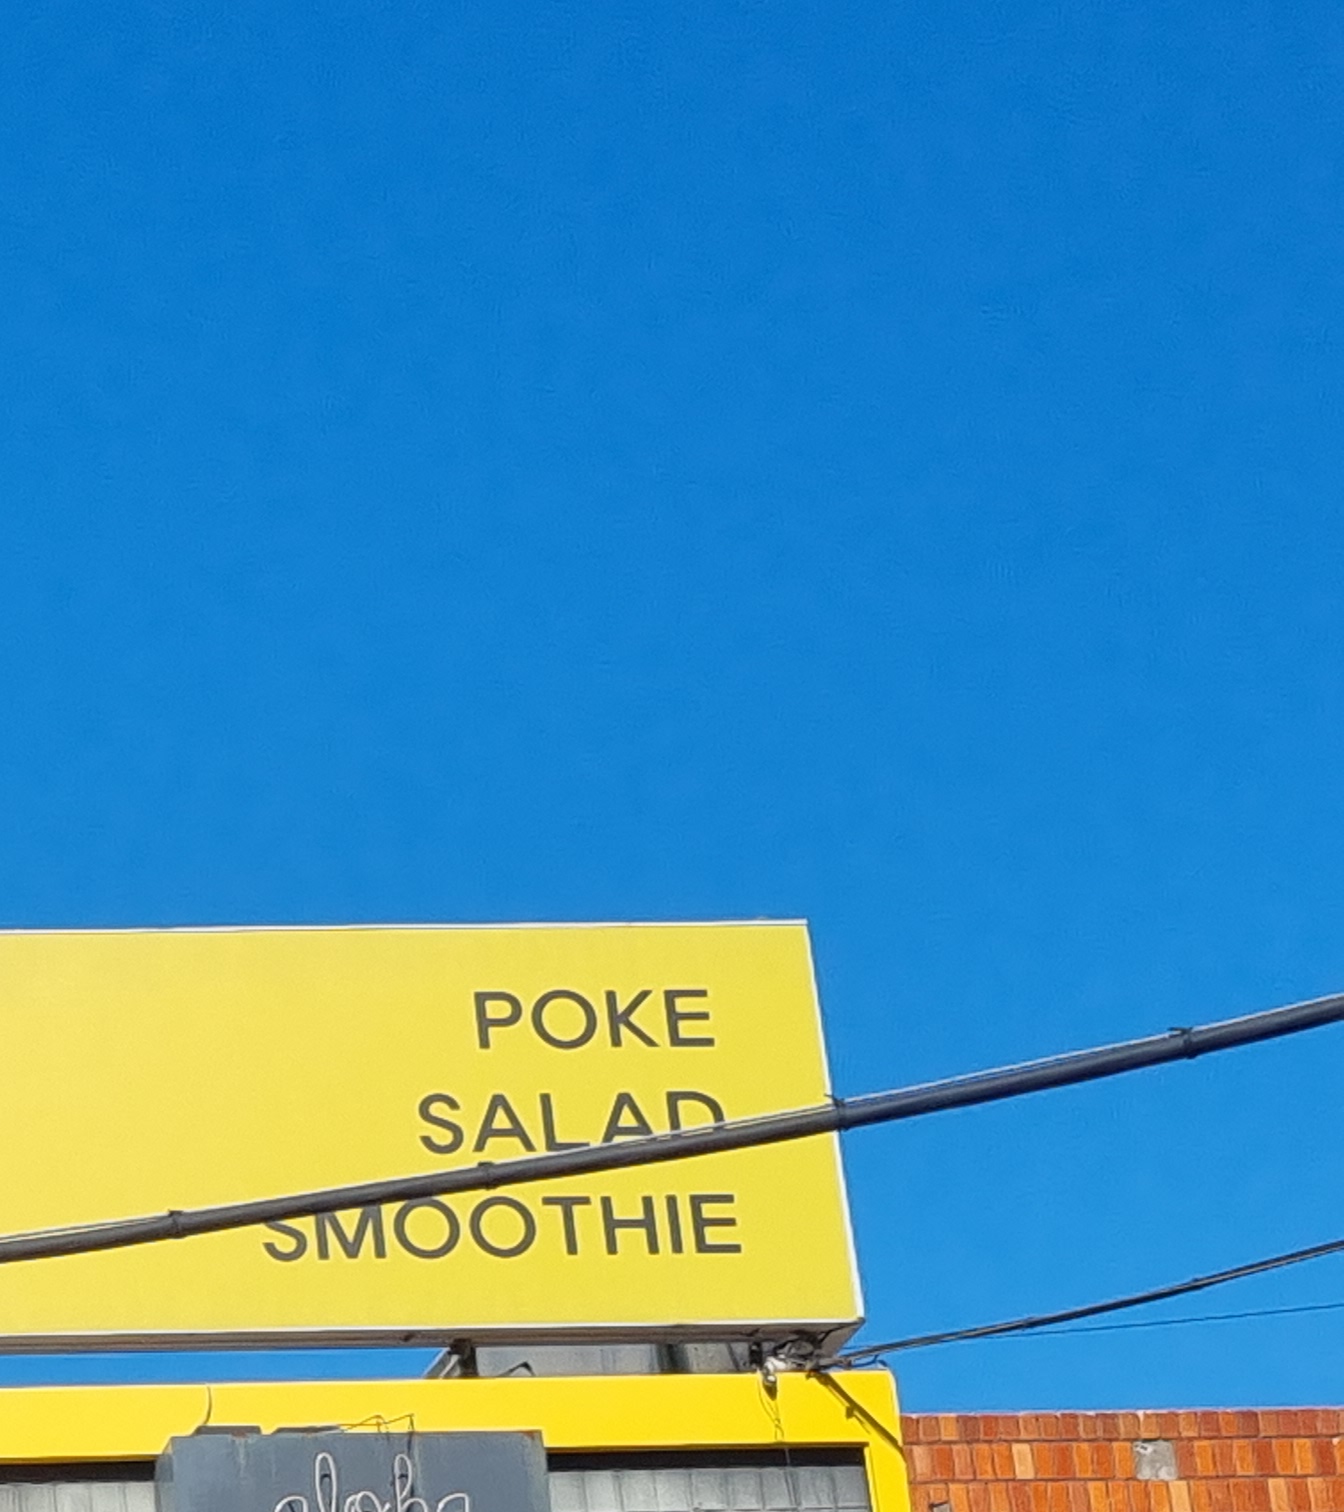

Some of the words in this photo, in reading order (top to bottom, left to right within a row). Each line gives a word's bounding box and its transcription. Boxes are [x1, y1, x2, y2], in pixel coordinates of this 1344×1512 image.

[473, 989, 716, 1050] POKE
[418, 1091, 724, 1154] SALAD
[263, 1193, 741, 1261] SMOOTHIE
